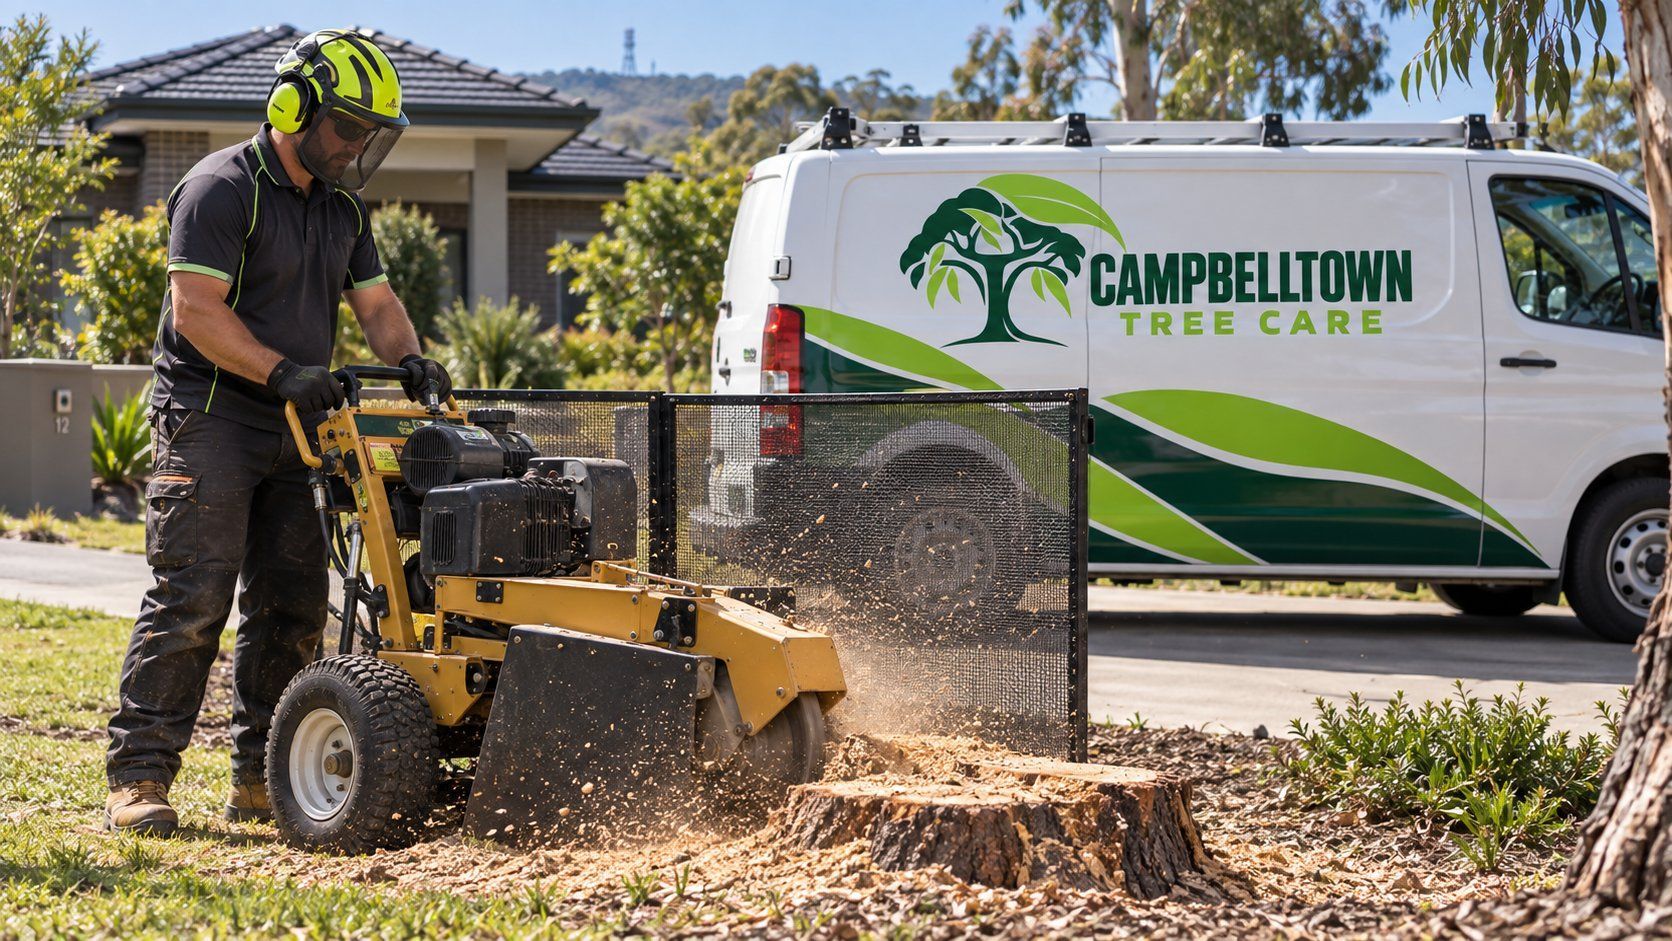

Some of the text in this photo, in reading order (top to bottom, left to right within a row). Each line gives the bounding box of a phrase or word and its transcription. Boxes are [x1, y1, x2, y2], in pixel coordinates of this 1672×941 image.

[1090, 250, 1413, 307] CAMPBELLTOWN
[1120, 309, 1383, 336] TREE CARE
[56, 417, 70, 434] 12
